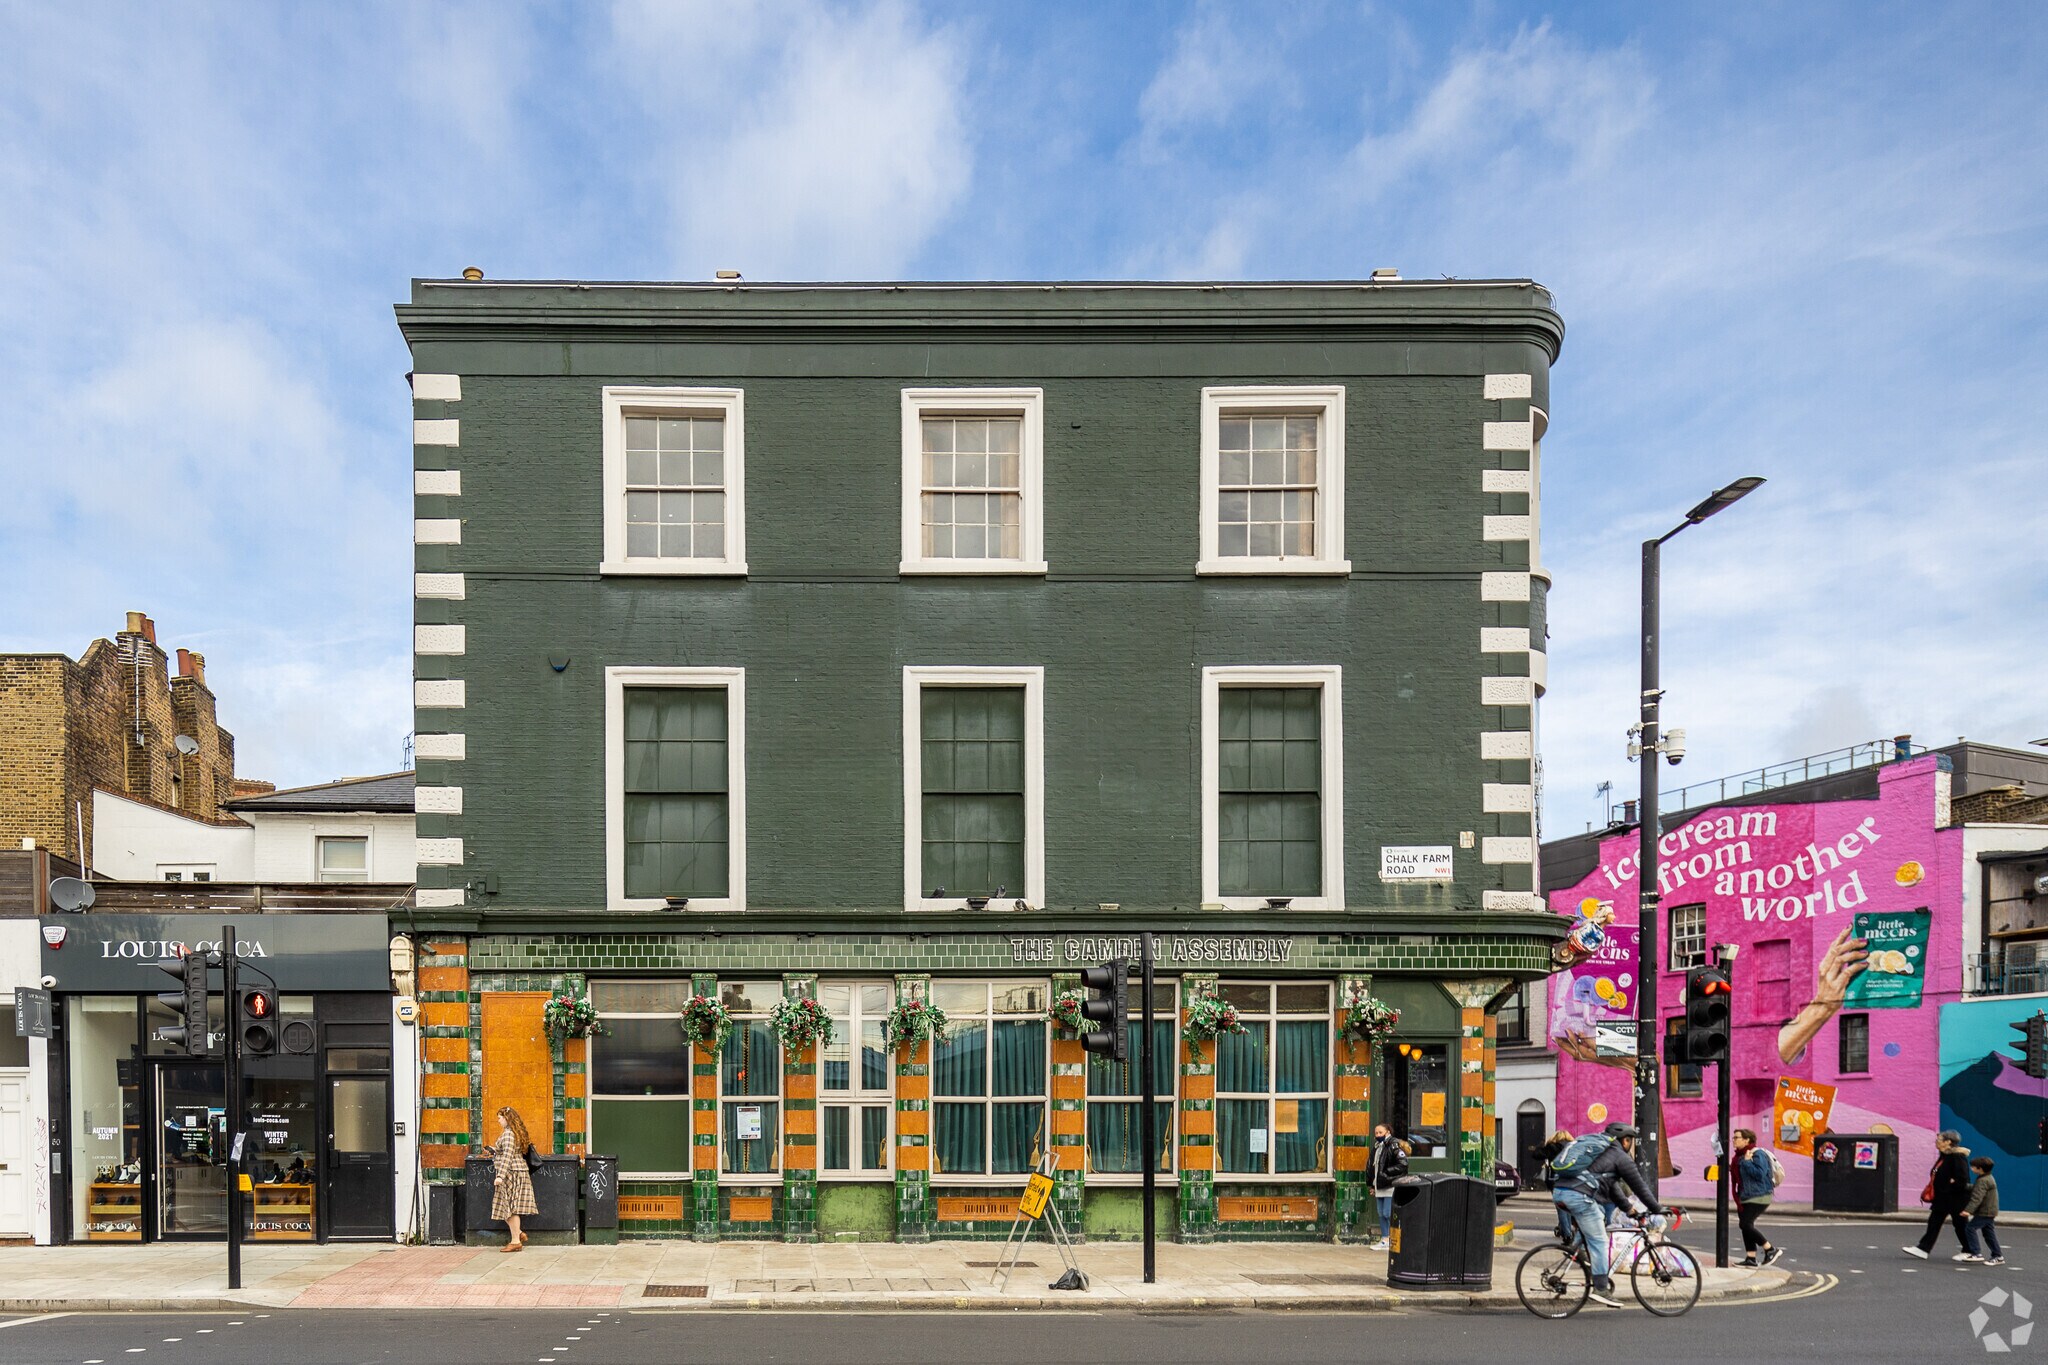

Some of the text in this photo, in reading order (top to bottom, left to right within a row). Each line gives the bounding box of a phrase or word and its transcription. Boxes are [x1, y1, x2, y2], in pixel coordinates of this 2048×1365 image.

[1658, 811, 1777, 857] cream
[1386, 854, 1450, 863] CHALK FARM
[1714, 816, 1882, 896] another
[1386, 866, 1415, 874] ROAD
[1656, 840, 1753, 895] from
[1741, 870, 1869, 922] world
[1877, 920, 1904, 930] little
[1865, 927, 1917, 939] moons
[101, 940, 184, 959] LOUIS
[1011, 938, 1053, 961] THE
[1172, 938, 1293, 962] ASSEMBLY
[1616, 1026, 1636, 1034] CCTV
[1796, 1085, 1816, 1095] little
[1785, 1090, 1824, 1104] moons
[250, 1222, 311, 1230] LOUIS COCA
